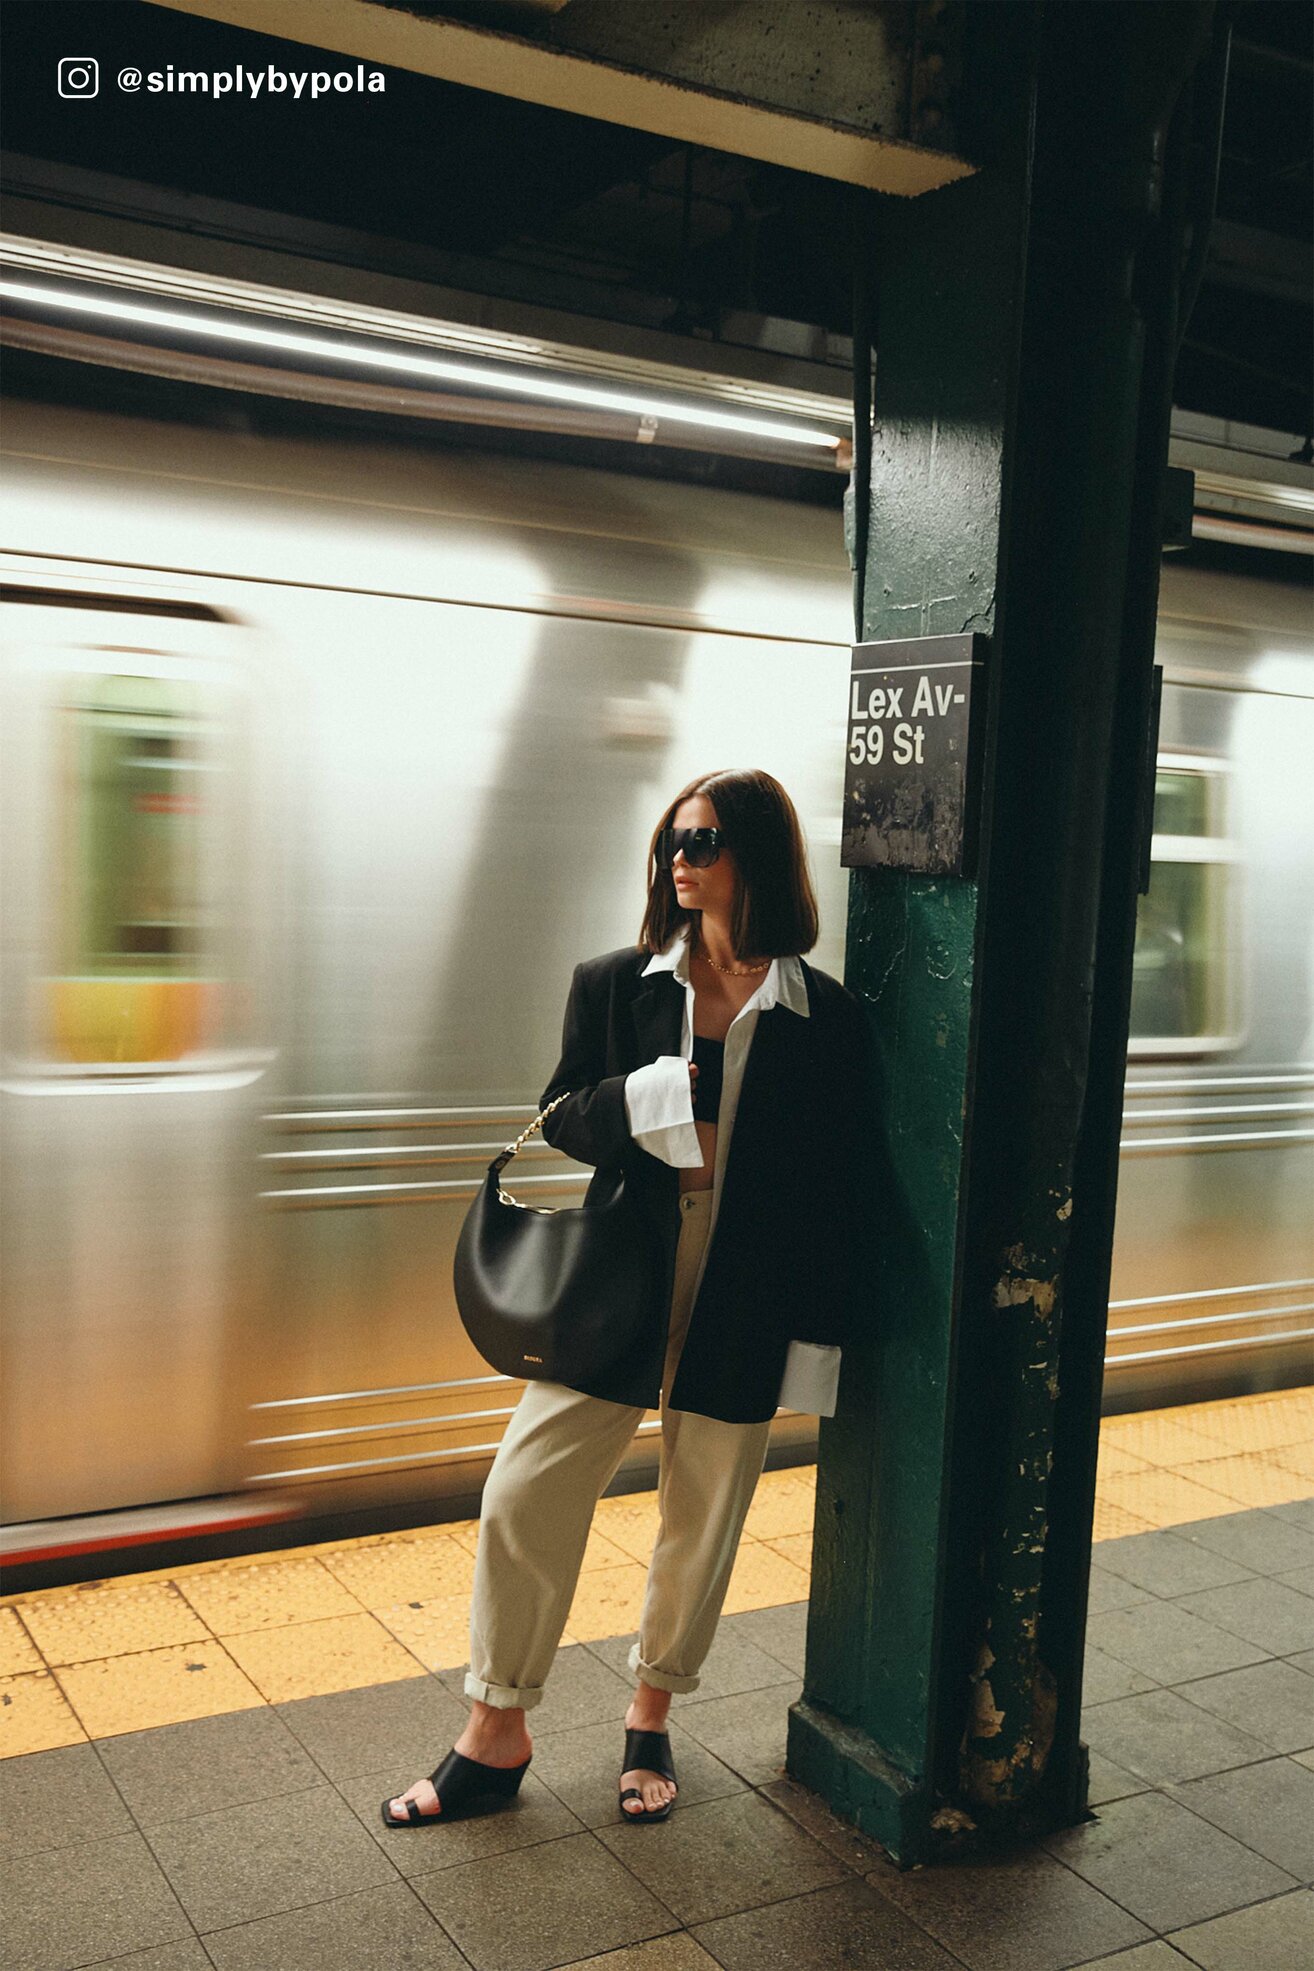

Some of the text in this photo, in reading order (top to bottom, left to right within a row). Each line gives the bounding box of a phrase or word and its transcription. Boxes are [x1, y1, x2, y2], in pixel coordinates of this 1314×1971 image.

[851, 676, 965, 720] Lex Av-
[850, 722, 925, 766] 59 St
